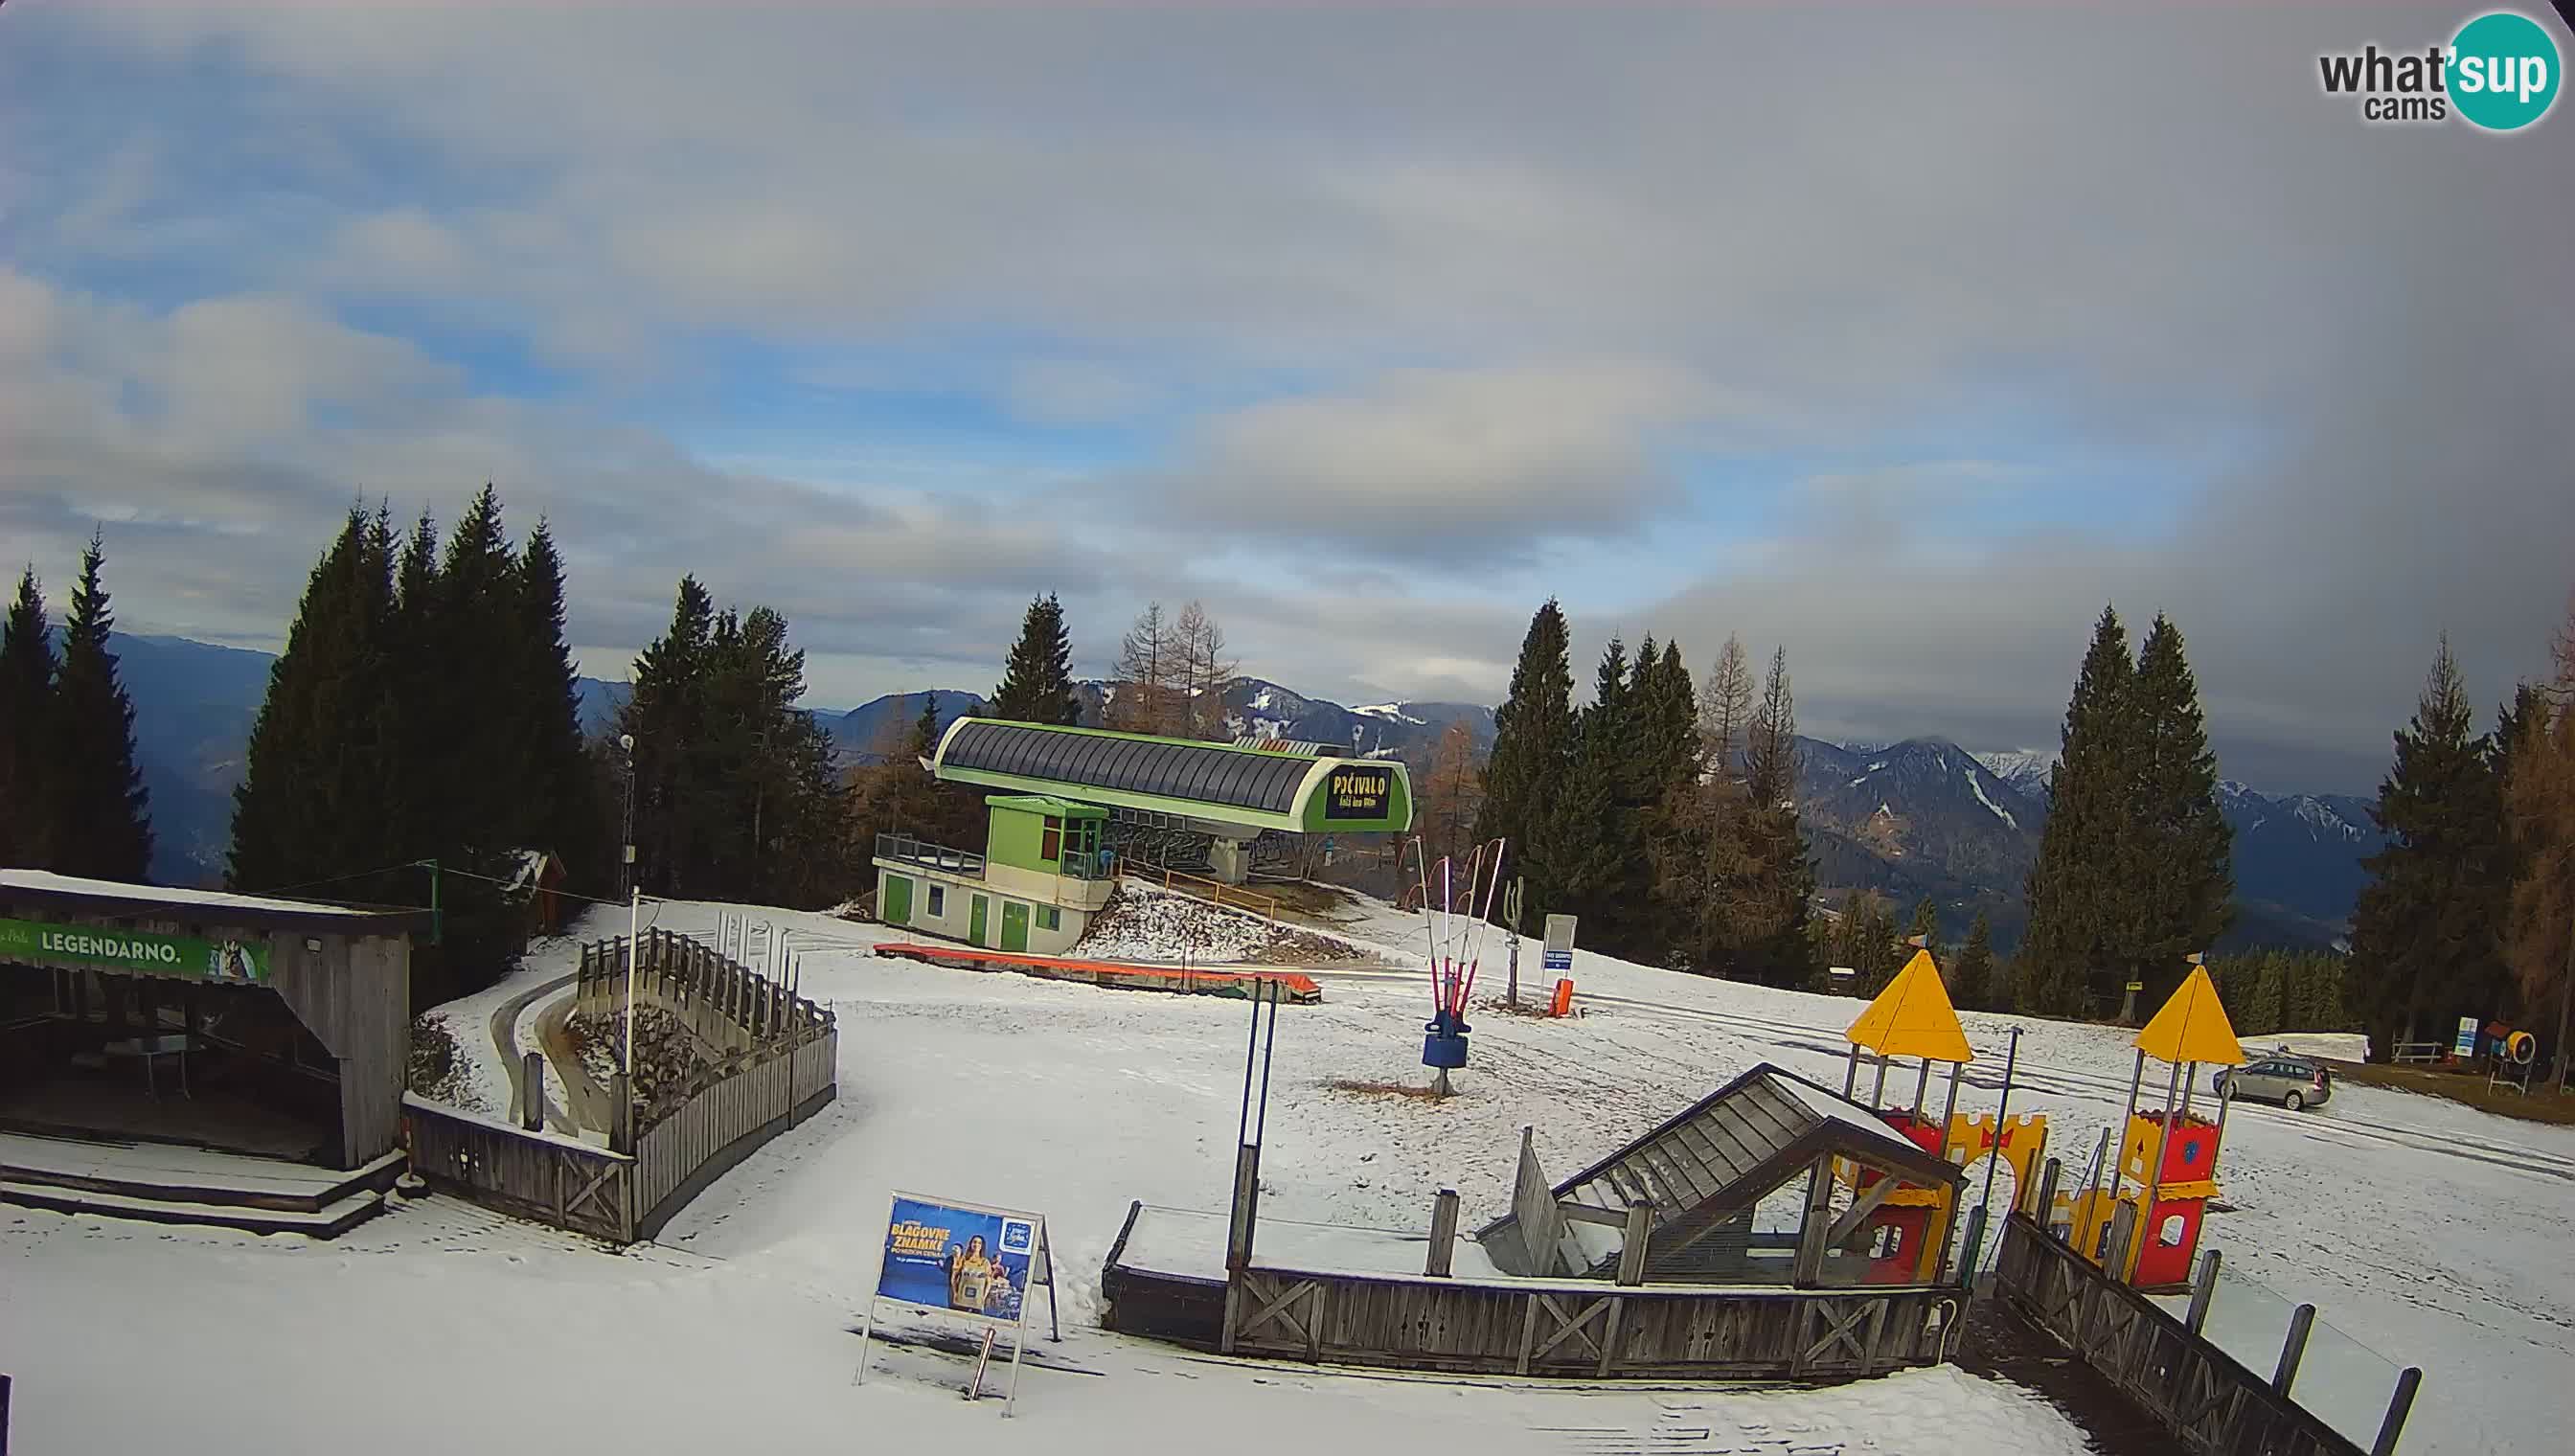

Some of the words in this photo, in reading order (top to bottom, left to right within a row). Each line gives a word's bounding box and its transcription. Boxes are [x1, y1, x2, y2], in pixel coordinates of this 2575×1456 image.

[41, 931, 181, 964] LEGENDARNO.
[891, 1223, 951, 1240] BLAGOVNE
[893, 1236, 944, 1252] ZNAMKE
